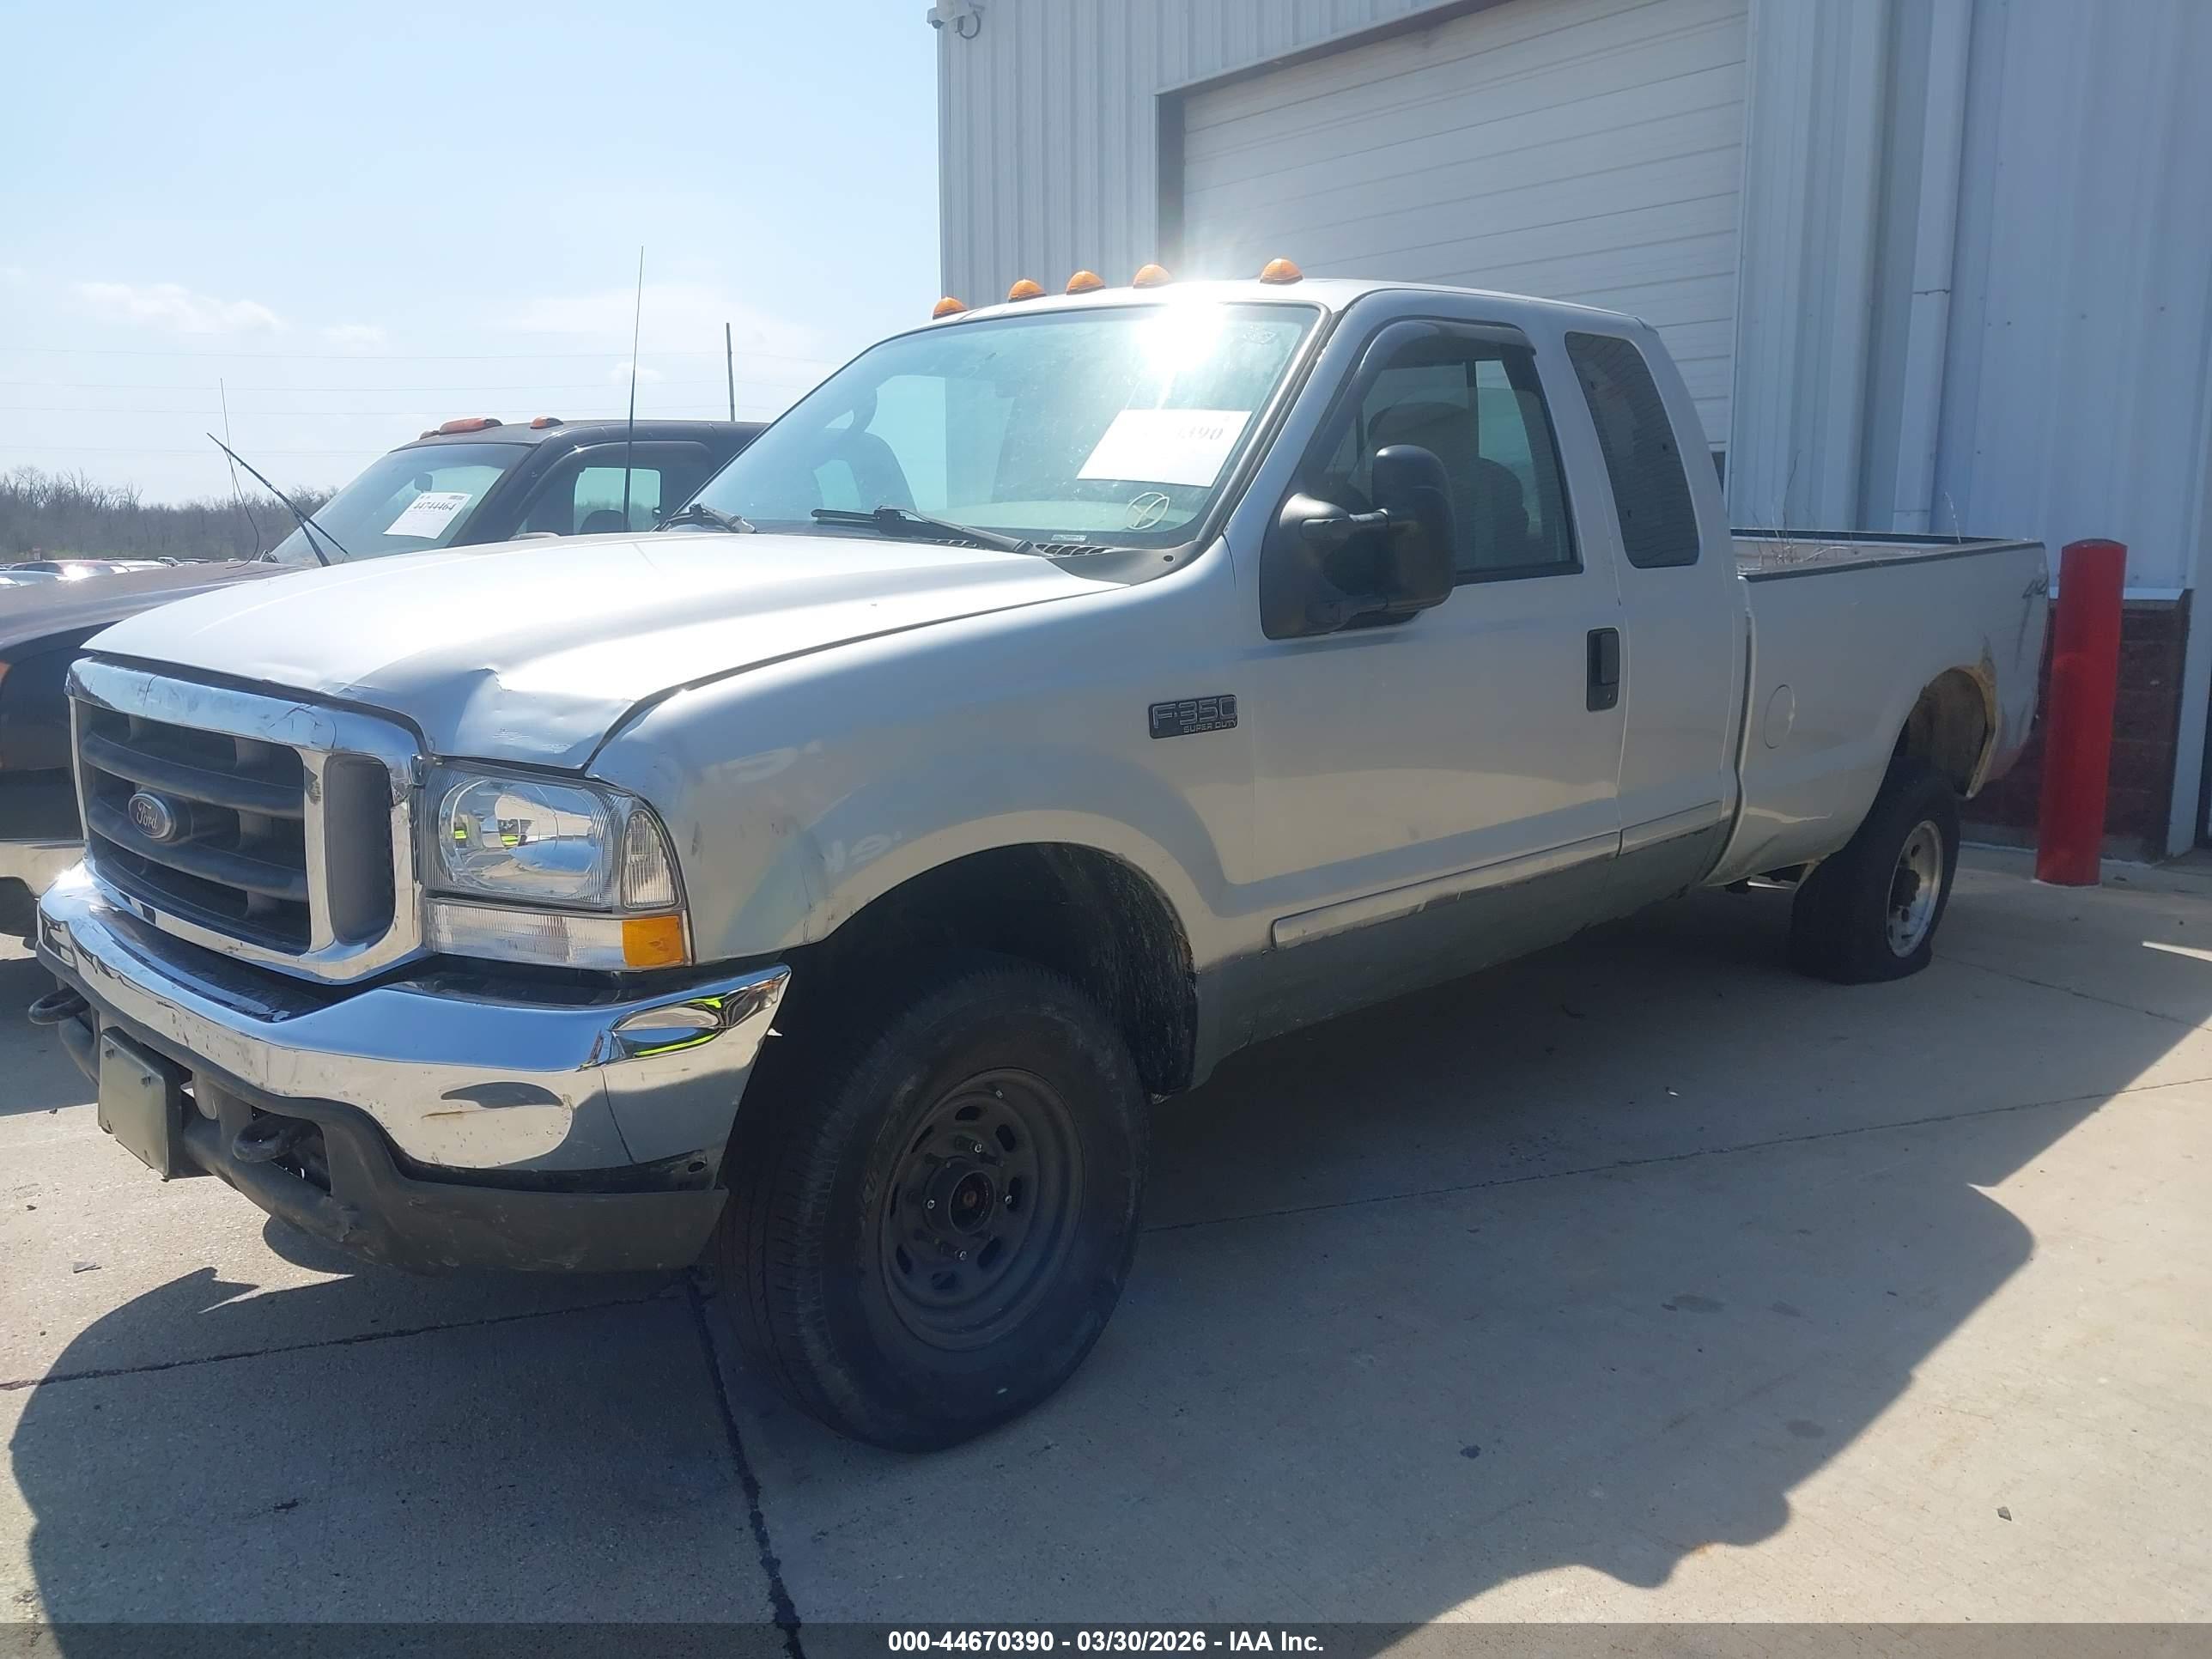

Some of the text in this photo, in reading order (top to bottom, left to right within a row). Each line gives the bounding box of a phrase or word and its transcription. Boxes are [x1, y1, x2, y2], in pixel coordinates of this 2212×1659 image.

[1183, 720, 1237, 733] SUPER DUTY
[137, 801, 158, 830] Ford
